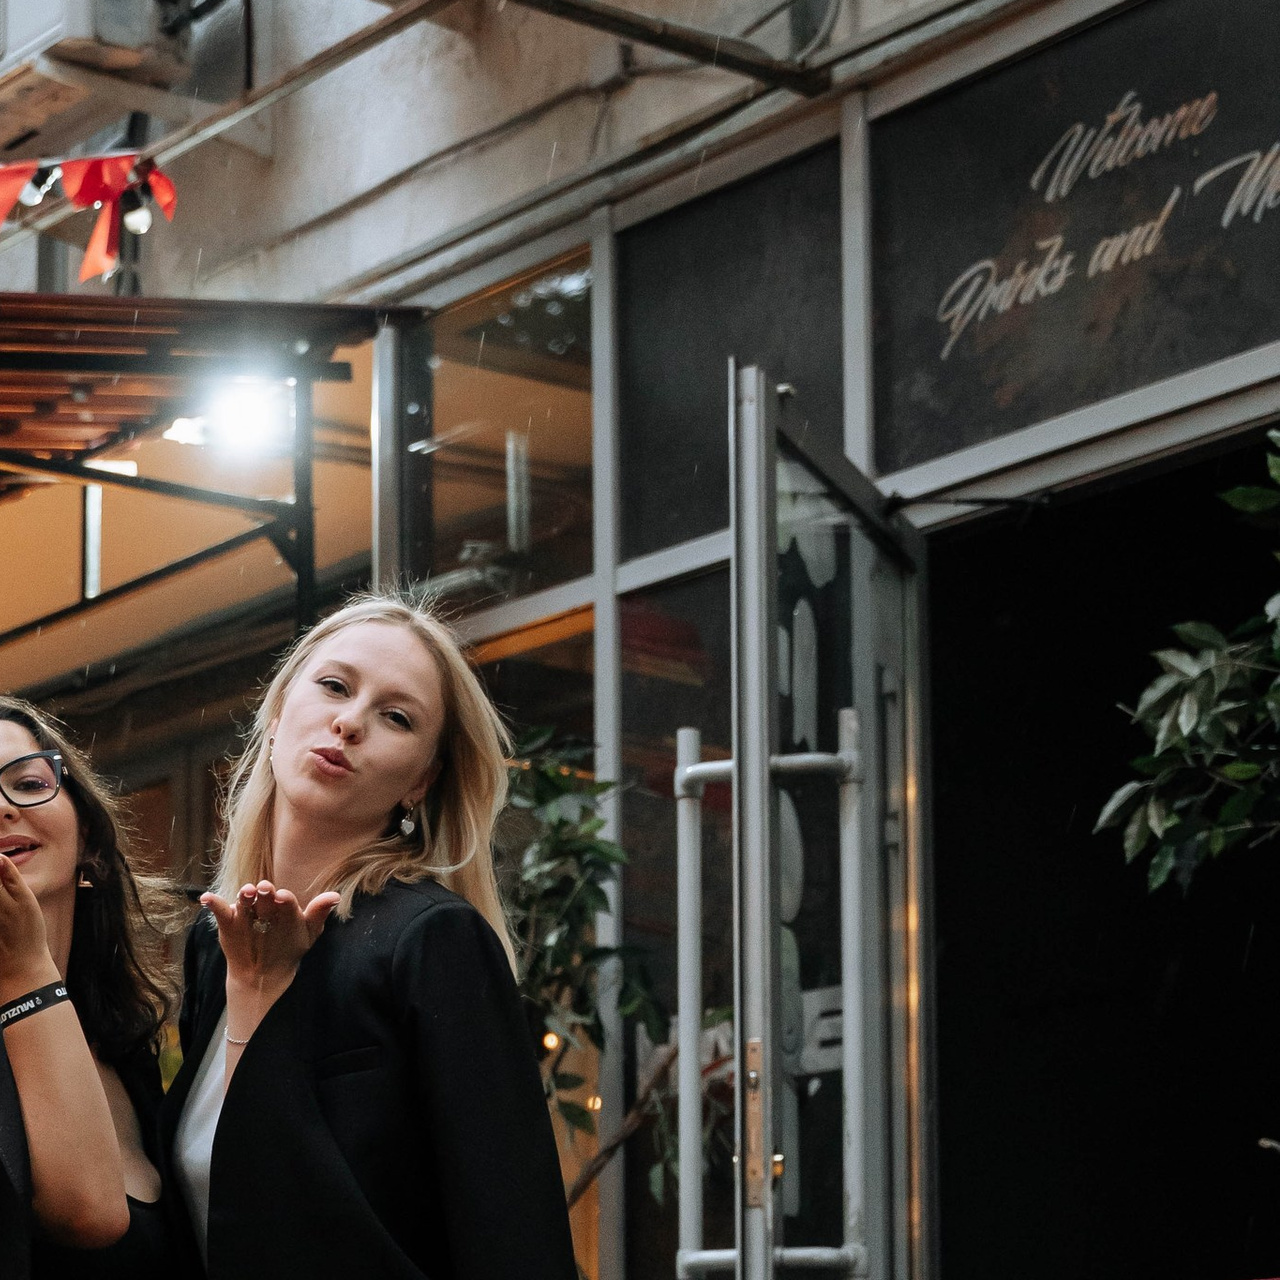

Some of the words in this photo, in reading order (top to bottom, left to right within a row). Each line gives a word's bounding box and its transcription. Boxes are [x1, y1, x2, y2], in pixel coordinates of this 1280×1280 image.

[1030, 89, 1218, 203] Welcome
[936, 233, 1075, 361] Drinks
[1086, 185, 1182, 279] and
